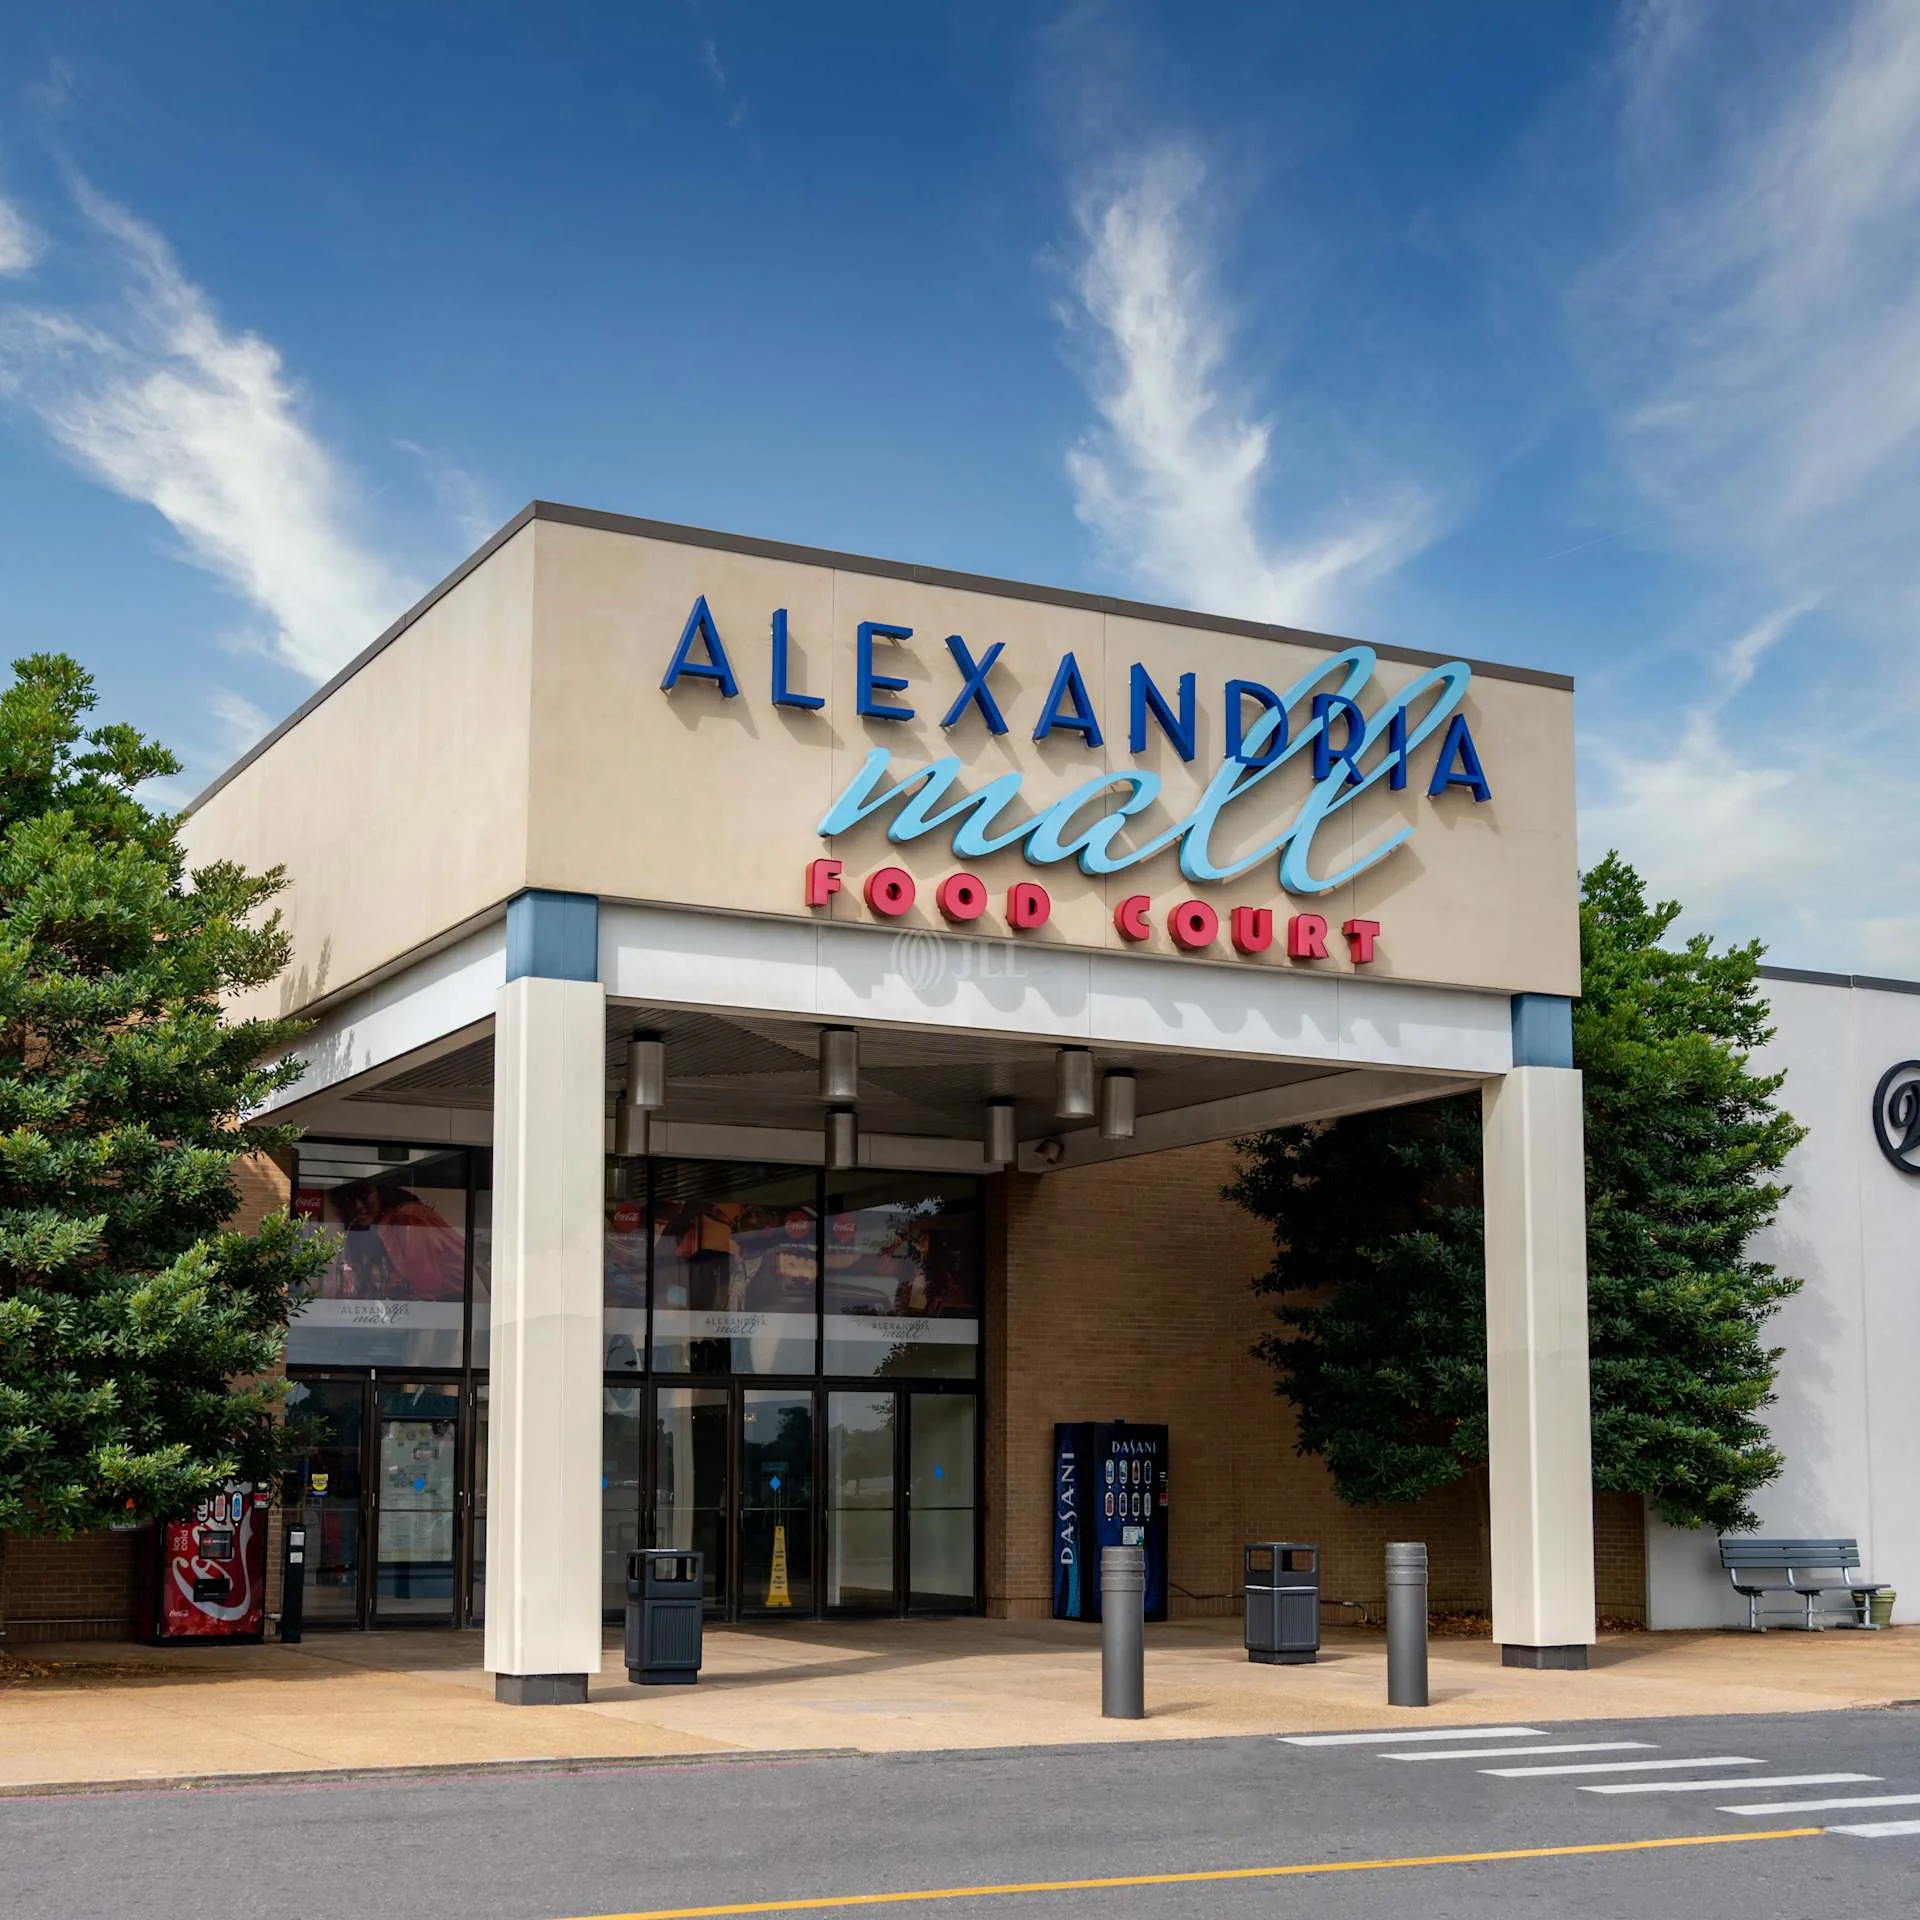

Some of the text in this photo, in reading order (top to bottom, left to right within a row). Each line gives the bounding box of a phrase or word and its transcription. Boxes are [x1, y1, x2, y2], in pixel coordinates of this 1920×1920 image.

[661, 595, 1490, 802] ALEXANDRIA
[816, 645, 1471, 896] mall
[806, 858, 1380, 965] FOOD COURT
[1111, 1438, 1156, 1455] DASANI
[1058, 1452, 1077, 1565] DASANI
